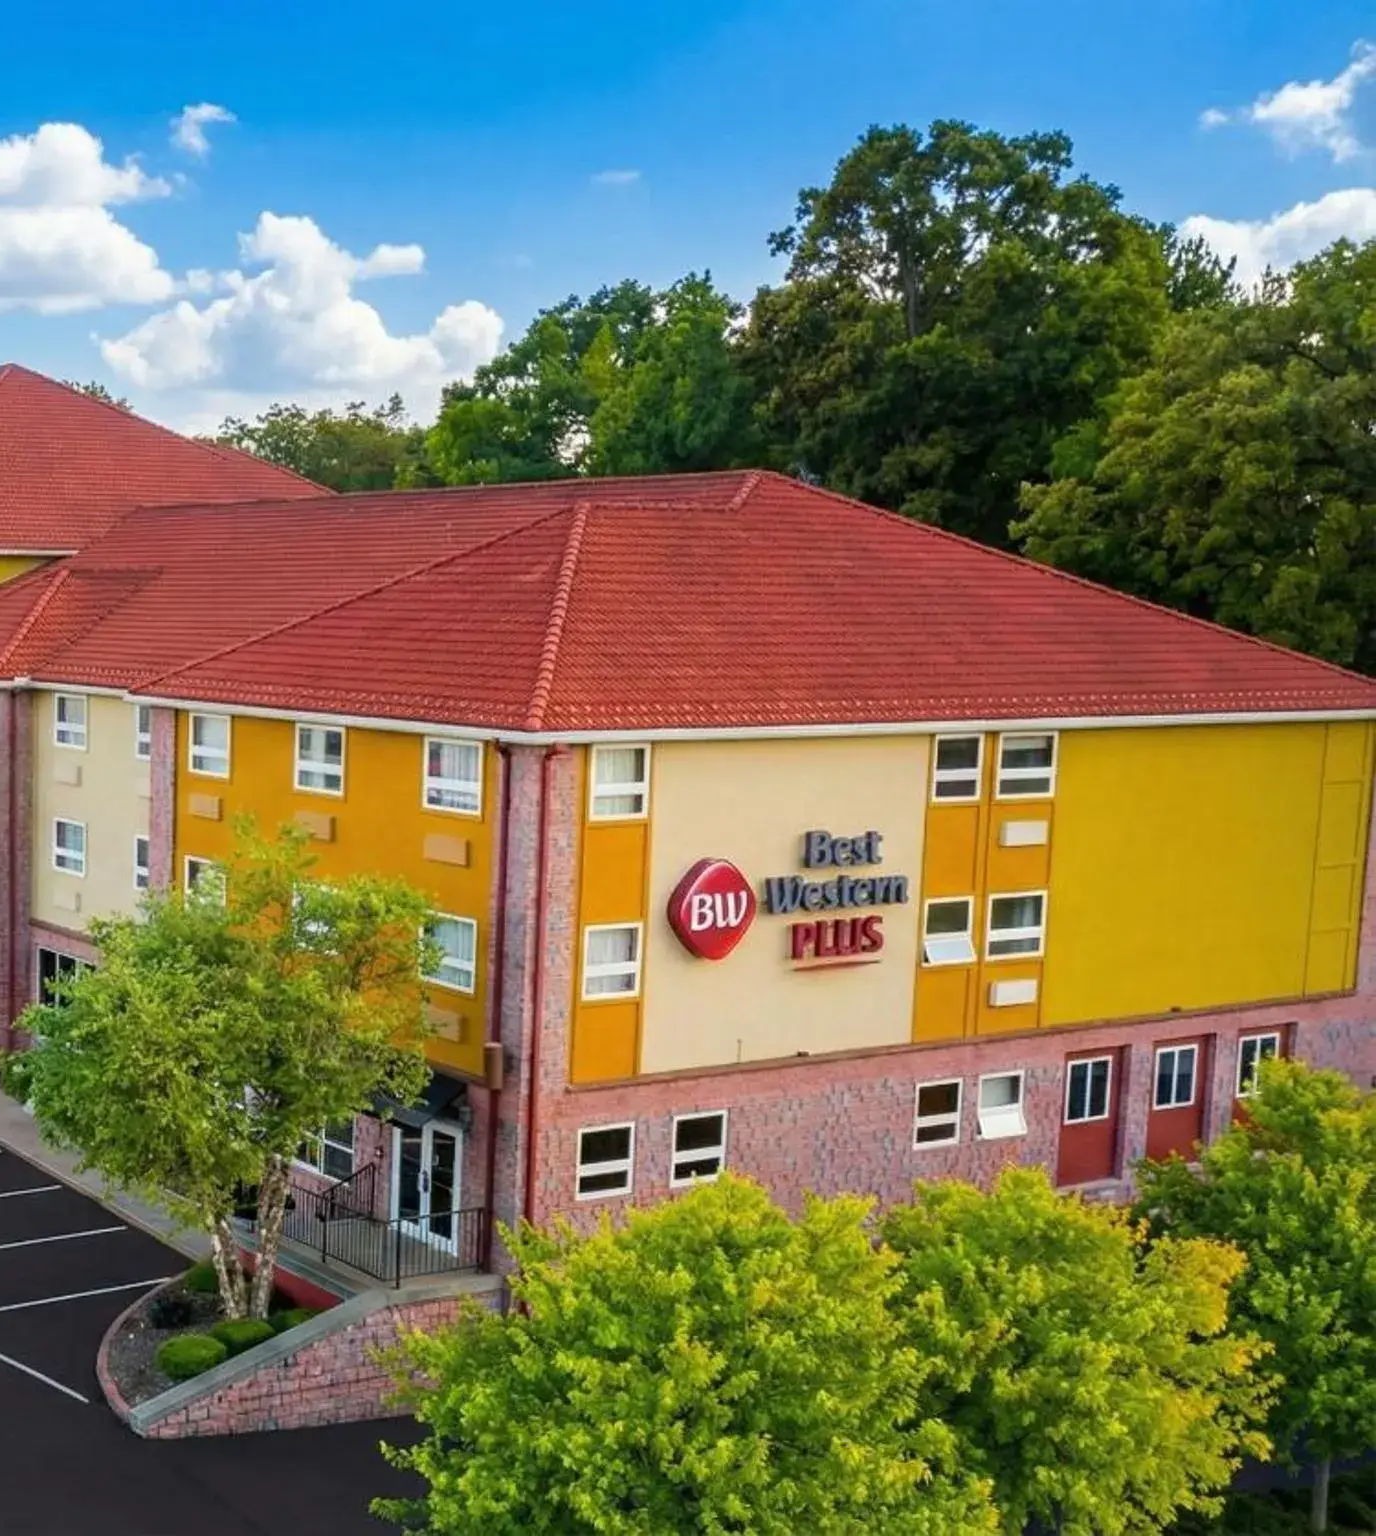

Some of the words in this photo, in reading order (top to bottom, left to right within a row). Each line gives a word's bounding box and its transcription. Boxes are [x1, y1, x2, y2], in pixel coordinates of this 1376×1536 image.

[803, 830, 883, 868] Best
[689, 890, 749, 932] BW
[764, 874, 909, 914] Western
[789, 915, 884, 959] PLUS
